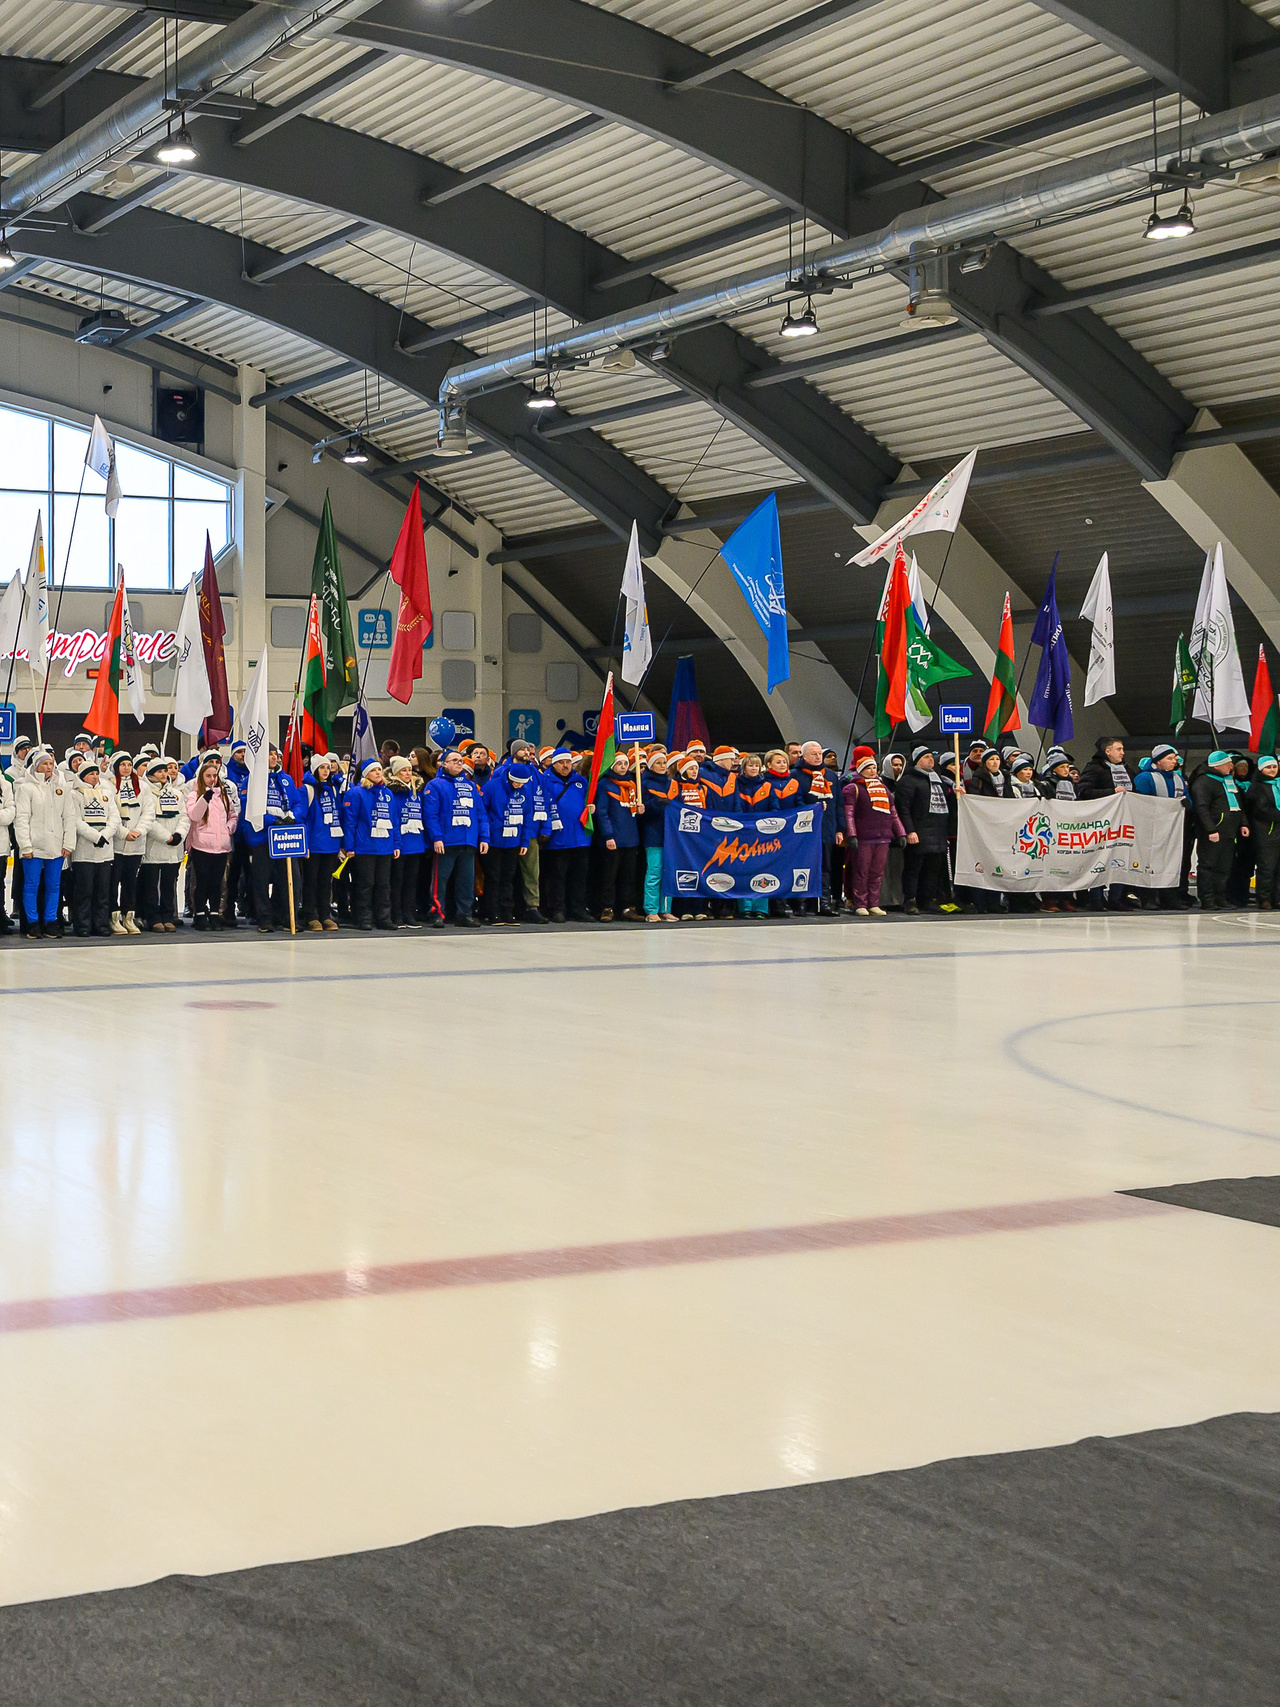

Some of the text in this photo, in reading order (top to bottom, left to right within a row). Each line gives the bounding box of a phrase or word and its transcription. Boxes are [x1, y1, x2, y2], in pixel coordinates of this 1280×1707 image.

[623, 723, 649, 732] Молния
[1056, 819, 1111, 831] КОМАНДА
[1057, 824, 1135, 849] ЕДИНЫЕ
[701, 835, 782, 876] Молния
